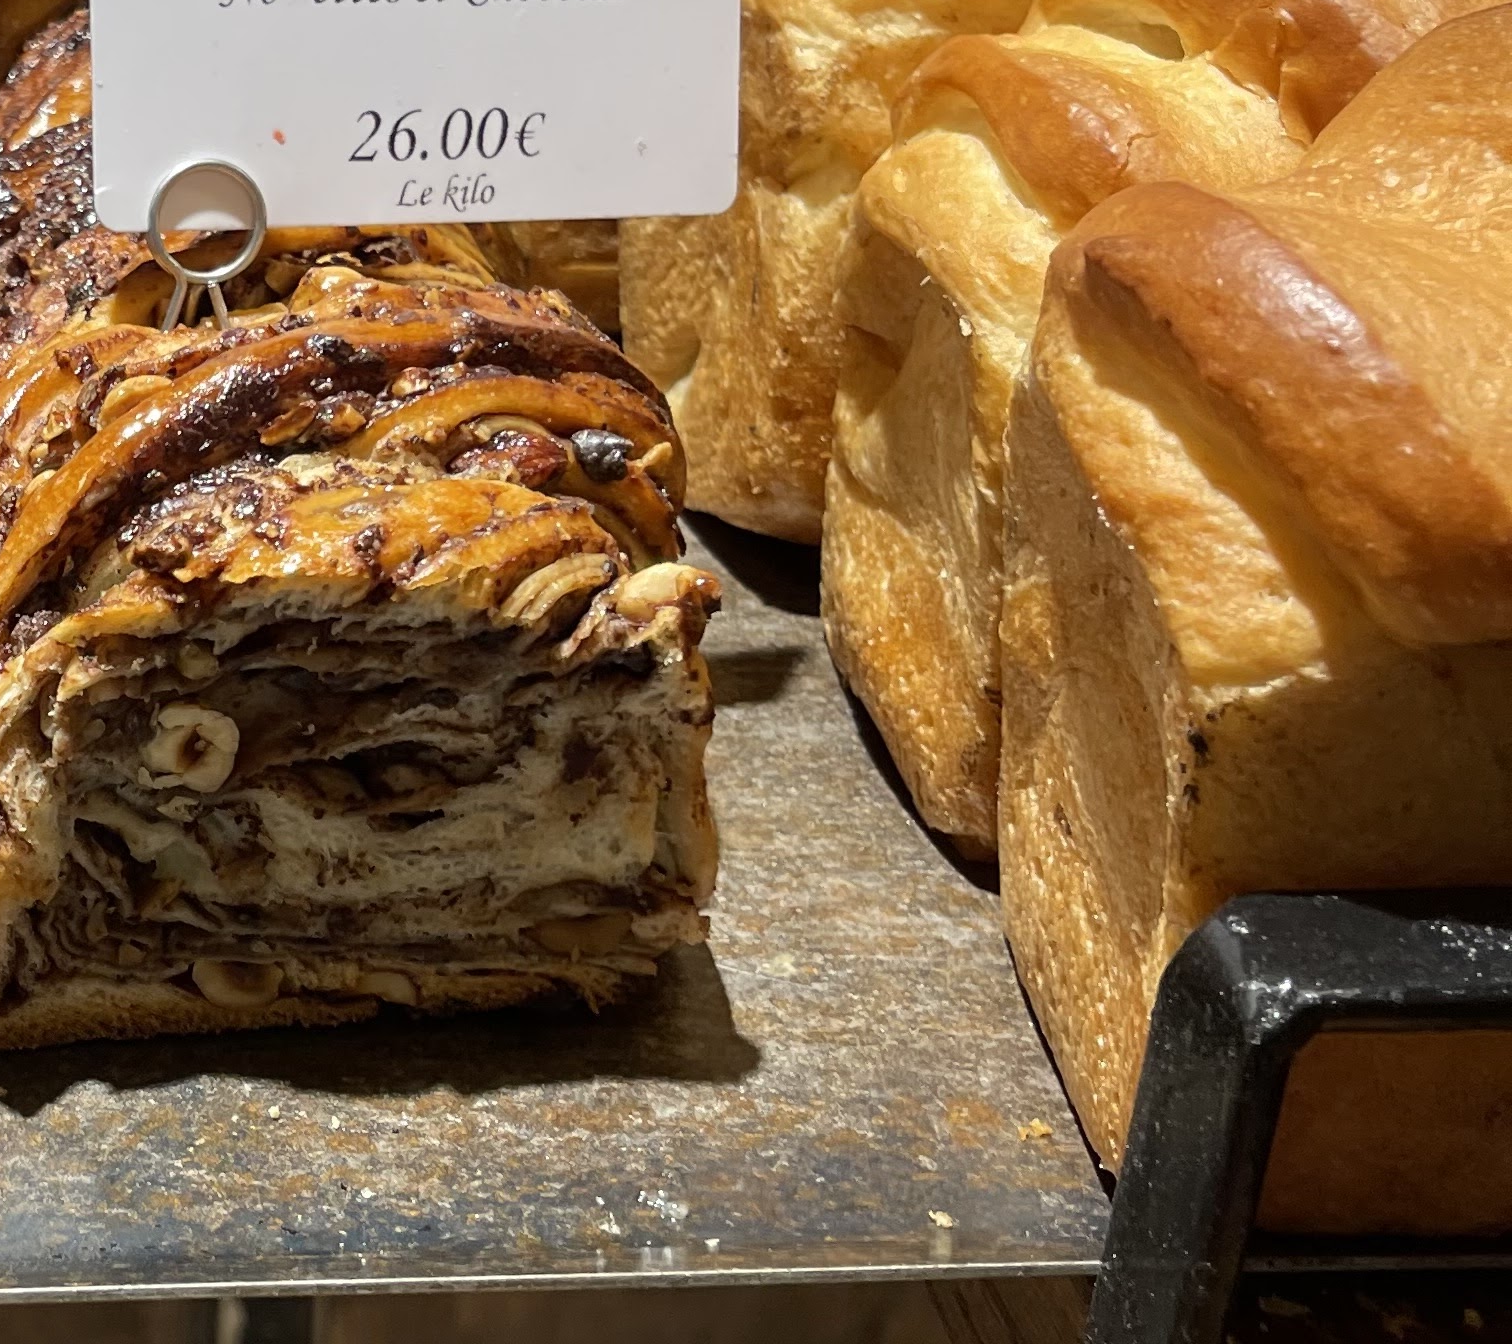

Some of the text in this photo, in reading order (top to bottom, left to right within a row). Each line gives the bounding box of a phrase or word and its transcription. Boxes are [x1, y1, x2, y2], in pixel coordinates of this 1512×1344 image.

[347, 106, 548, 163] 26.00€
[396, 172, 496, 213] Le kilo
